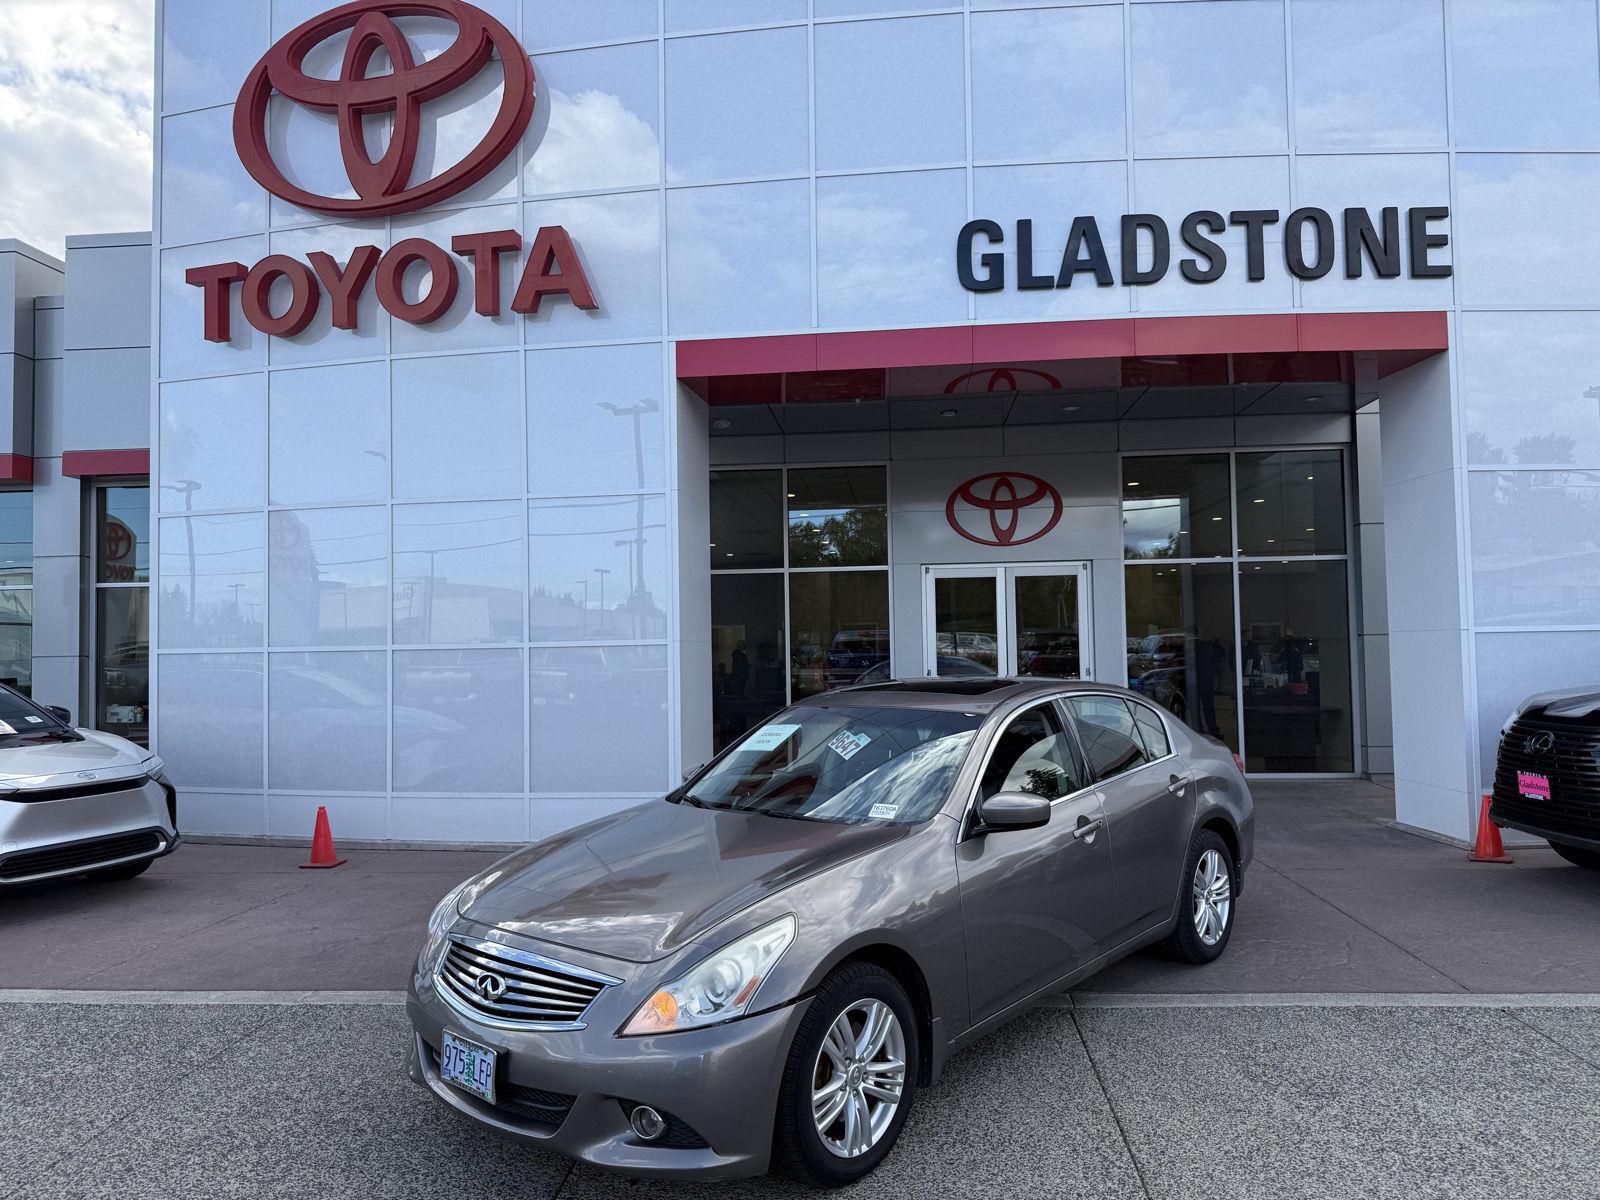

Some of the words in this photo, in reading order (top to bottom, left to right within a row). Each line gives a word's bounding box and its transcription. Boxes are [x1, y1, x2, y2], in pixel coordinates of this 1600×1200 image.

[956, 206, 1453, 294] GLADSTONE
[186, 225, 599, 343] TOYOTA
[830, 731, 862, 757] 9647
[1519, 779, 1550, 793] Gladstone
[444, 1043, 466, 1075] 975
[472, 1054, 492, 1088] LEP
